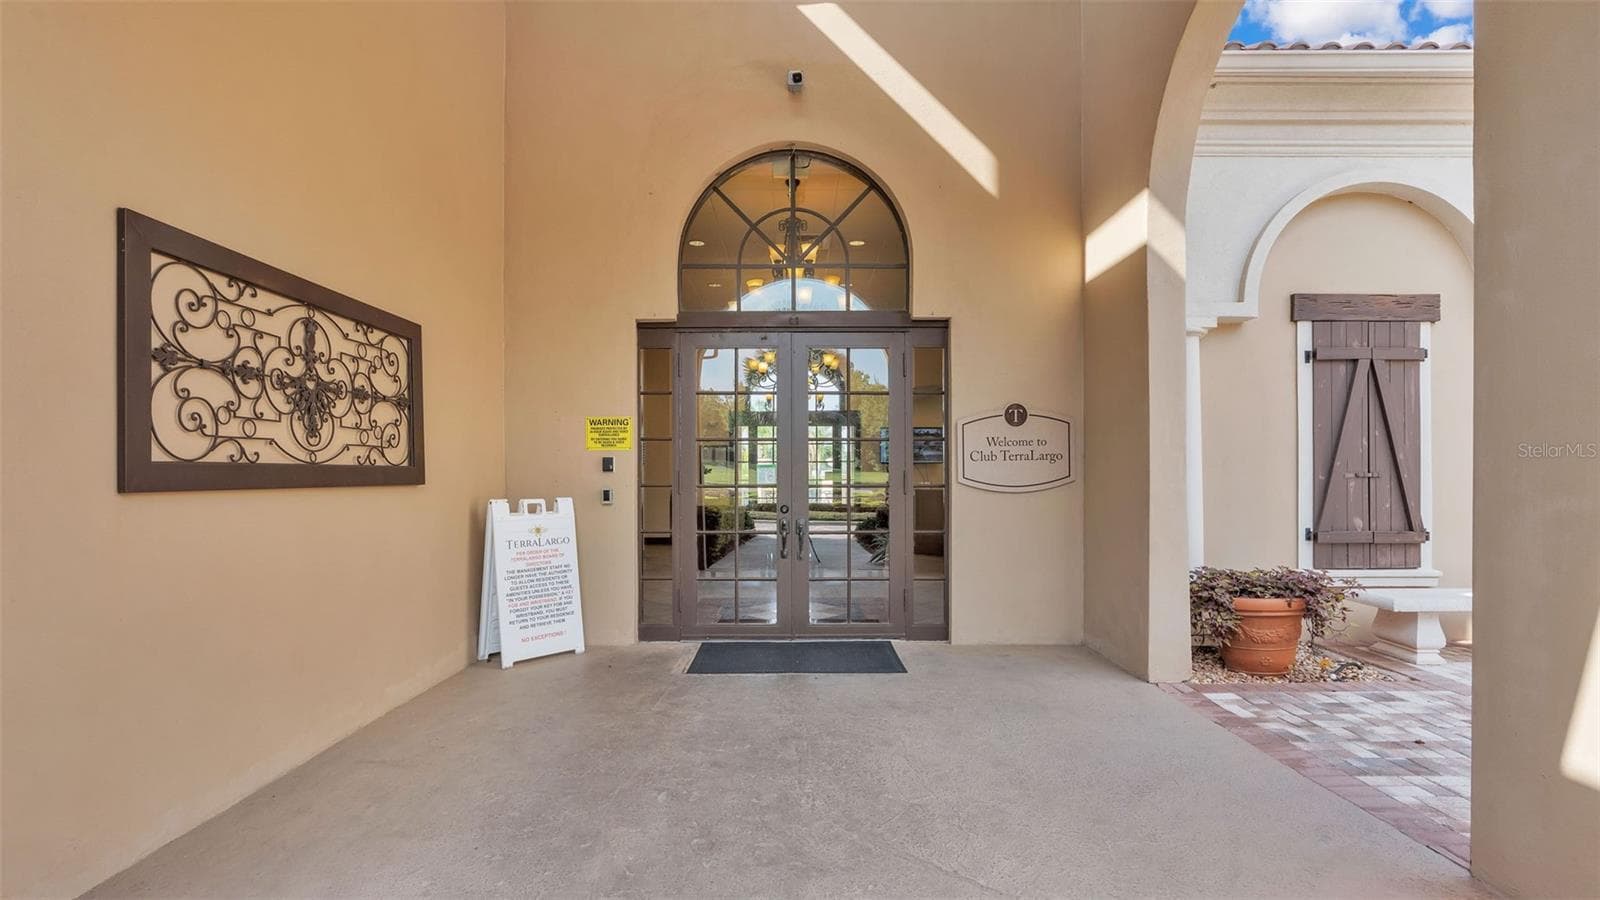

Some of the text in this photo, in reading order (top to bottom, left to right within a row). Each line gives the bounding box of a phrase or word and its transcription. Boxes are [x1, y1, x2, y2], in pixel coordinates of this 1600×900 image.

[1008, 409, 1023, 422] T
[986, 436, 1047, 447] Welcome to
[970, 450, 1063, 464] Club TerraLargo
